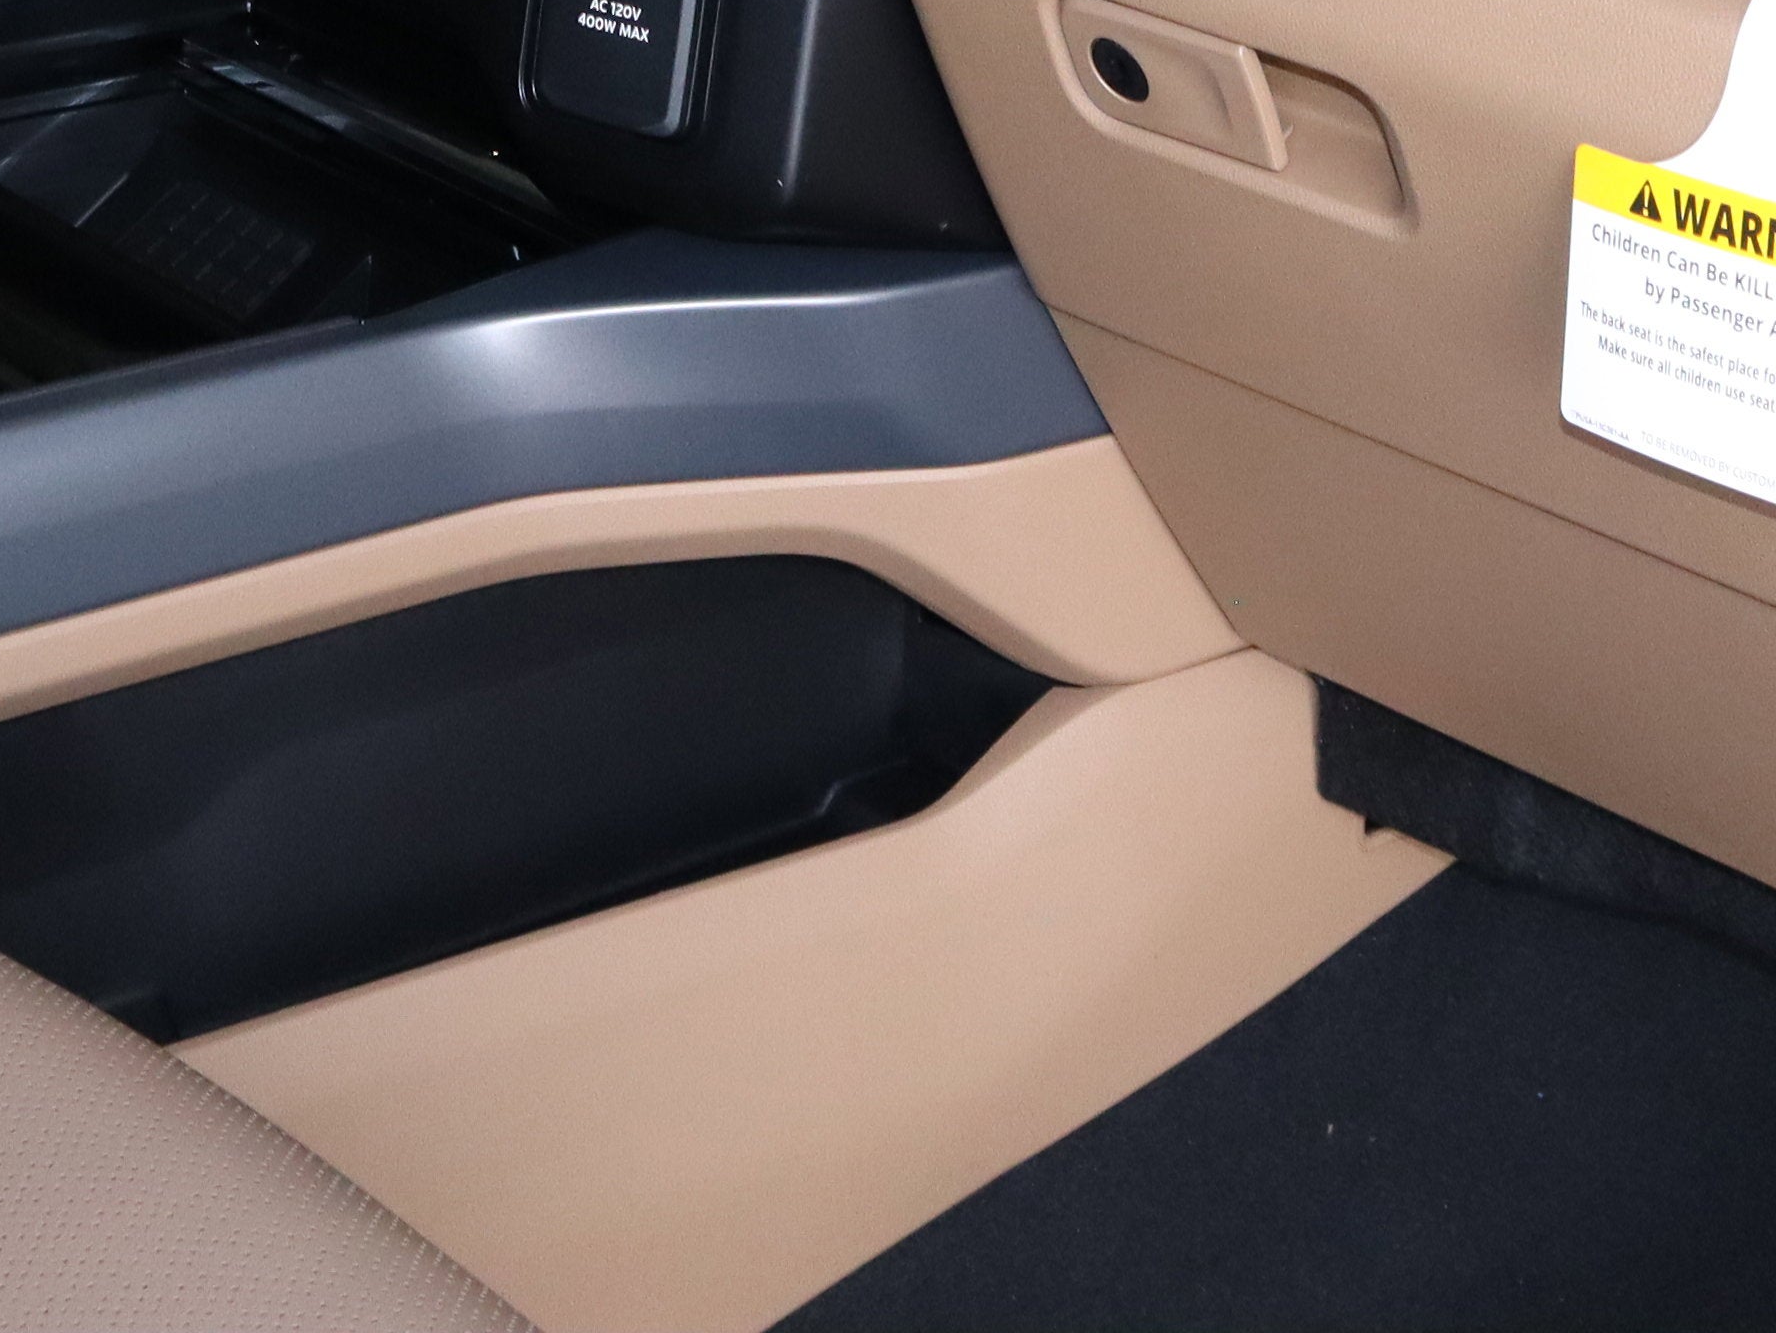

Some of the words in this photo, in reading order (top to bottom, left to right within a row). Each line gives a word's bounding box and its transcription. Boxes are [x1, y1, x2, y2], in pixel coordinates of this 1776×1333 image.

[578, 13, 616, 34] 400W
[619, 23, 649, 43] MAX
[610, 1, 642, 21] 120V
[1590, 222, 1661, 263] Children
[1665, 249, 1700, 277] Can
[1705, 261, 1728, 286] Be
[1644, 275, 1665, 305] by
[1669, 285, 1764, 333] Passenger
[1579, 299, 1599, 322] The
[1600, 308, 1626, 333] back
[1627, 323, 1651, 343] seat
[1653, 328, 1664, 347] is
[1666, 334, 1687, 355] the
[1688, 345, 1724, 369] safest
[1726, 357, 1760, 381] place
[1597, 333, 1628, 360] Make
[1629, 349, 1654, 371] sure
[1656, 358, 1671, 376] all
[1673, 364, 1721, 394] children
[1724, 384, 1746, 403] use
[1749, 393, 1775, 414] seat
[1640, 430, 1654, 446] TO
[1654, 435, 1668, 452] BE
[1669, 441, 1716, 470] REMOVED
[1718, 459, 1731, 475] BY
